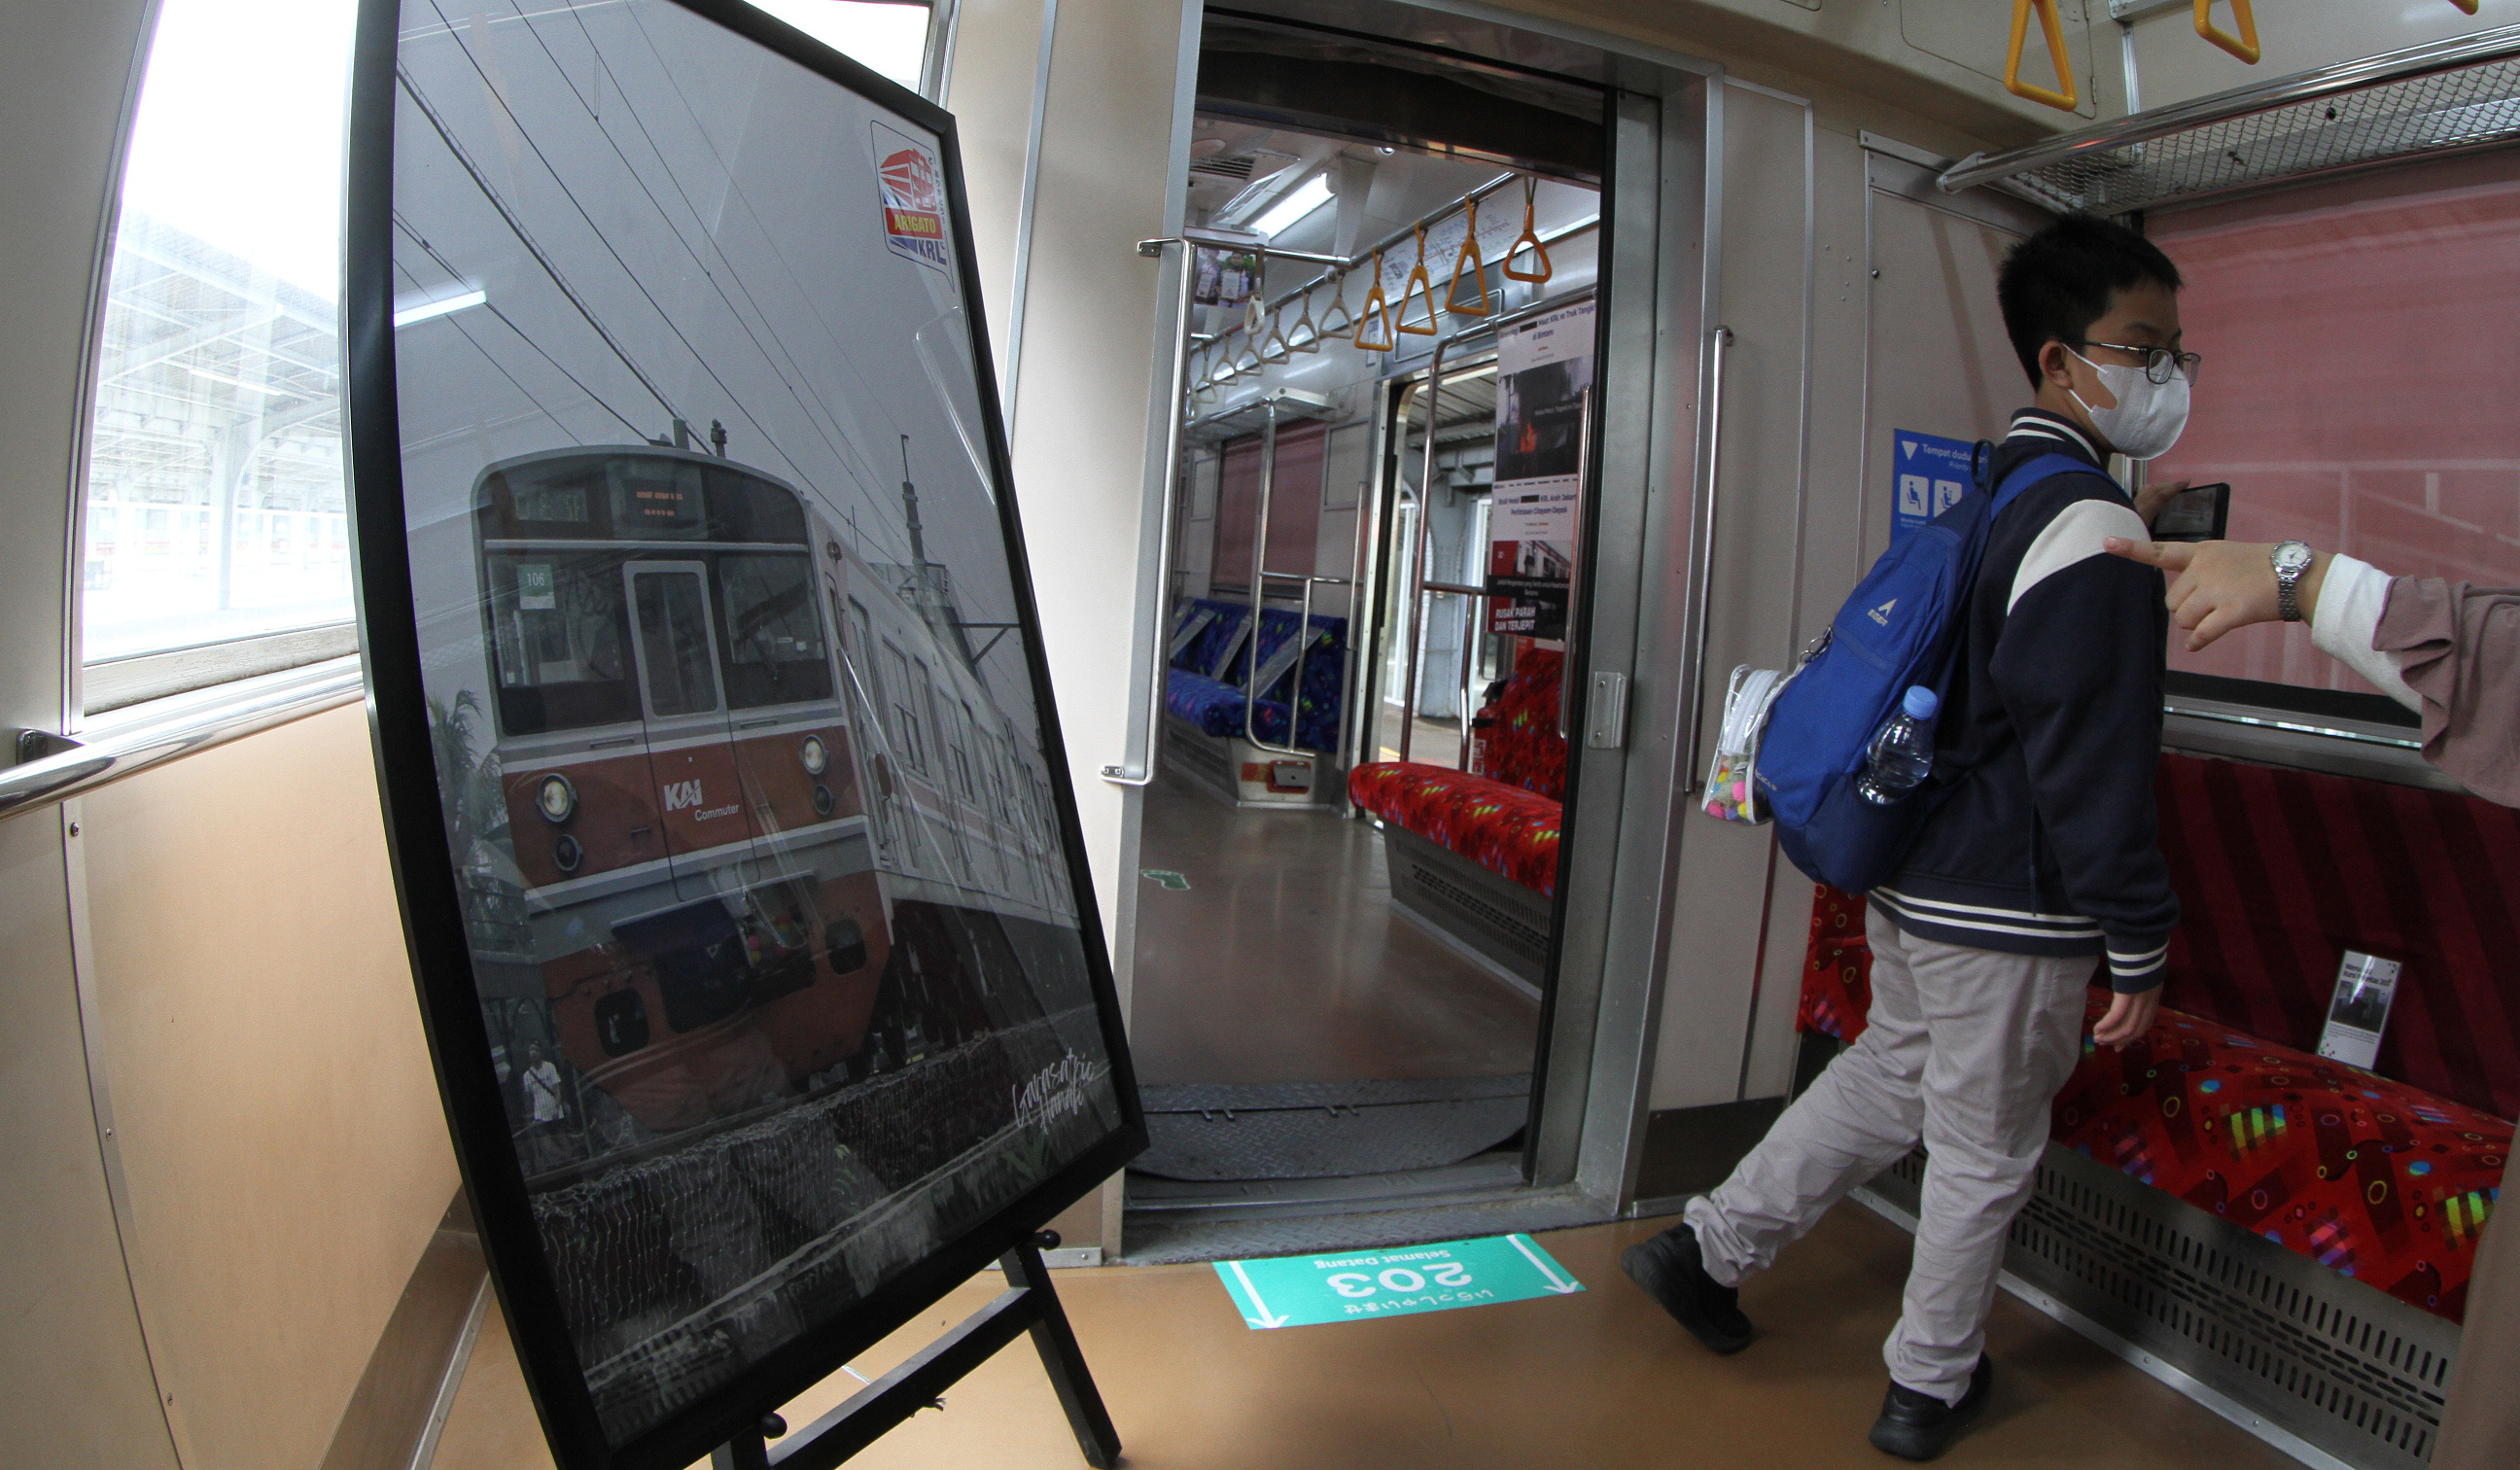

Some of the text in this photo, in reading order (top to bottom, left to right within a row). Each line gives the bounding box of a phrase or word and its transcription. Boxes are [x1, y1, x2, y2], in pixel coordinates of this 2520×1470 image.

[894, 214, 936, 234] ARIGATO
[918, 239, 947, 266] KRL
[1923, 444, 1951, 458] Tempat
[1952, 450, 1972, 462] dudu
[527, 573, 544, 586] 106
[1495, 606, 1536, 618] RUSAK PARAH
[1494, 619, 1535, 631] DAN TERJEPIT
[663, 779, 703, 812] KAI
[695, 804, 739, 822] Commuter
[1314, 1250, 1452, 1270] Selamat Datang
[1326, 1261, 1473, 1298] 203
[1344, 1289, 1494, 1314] いらっしゃいませ
